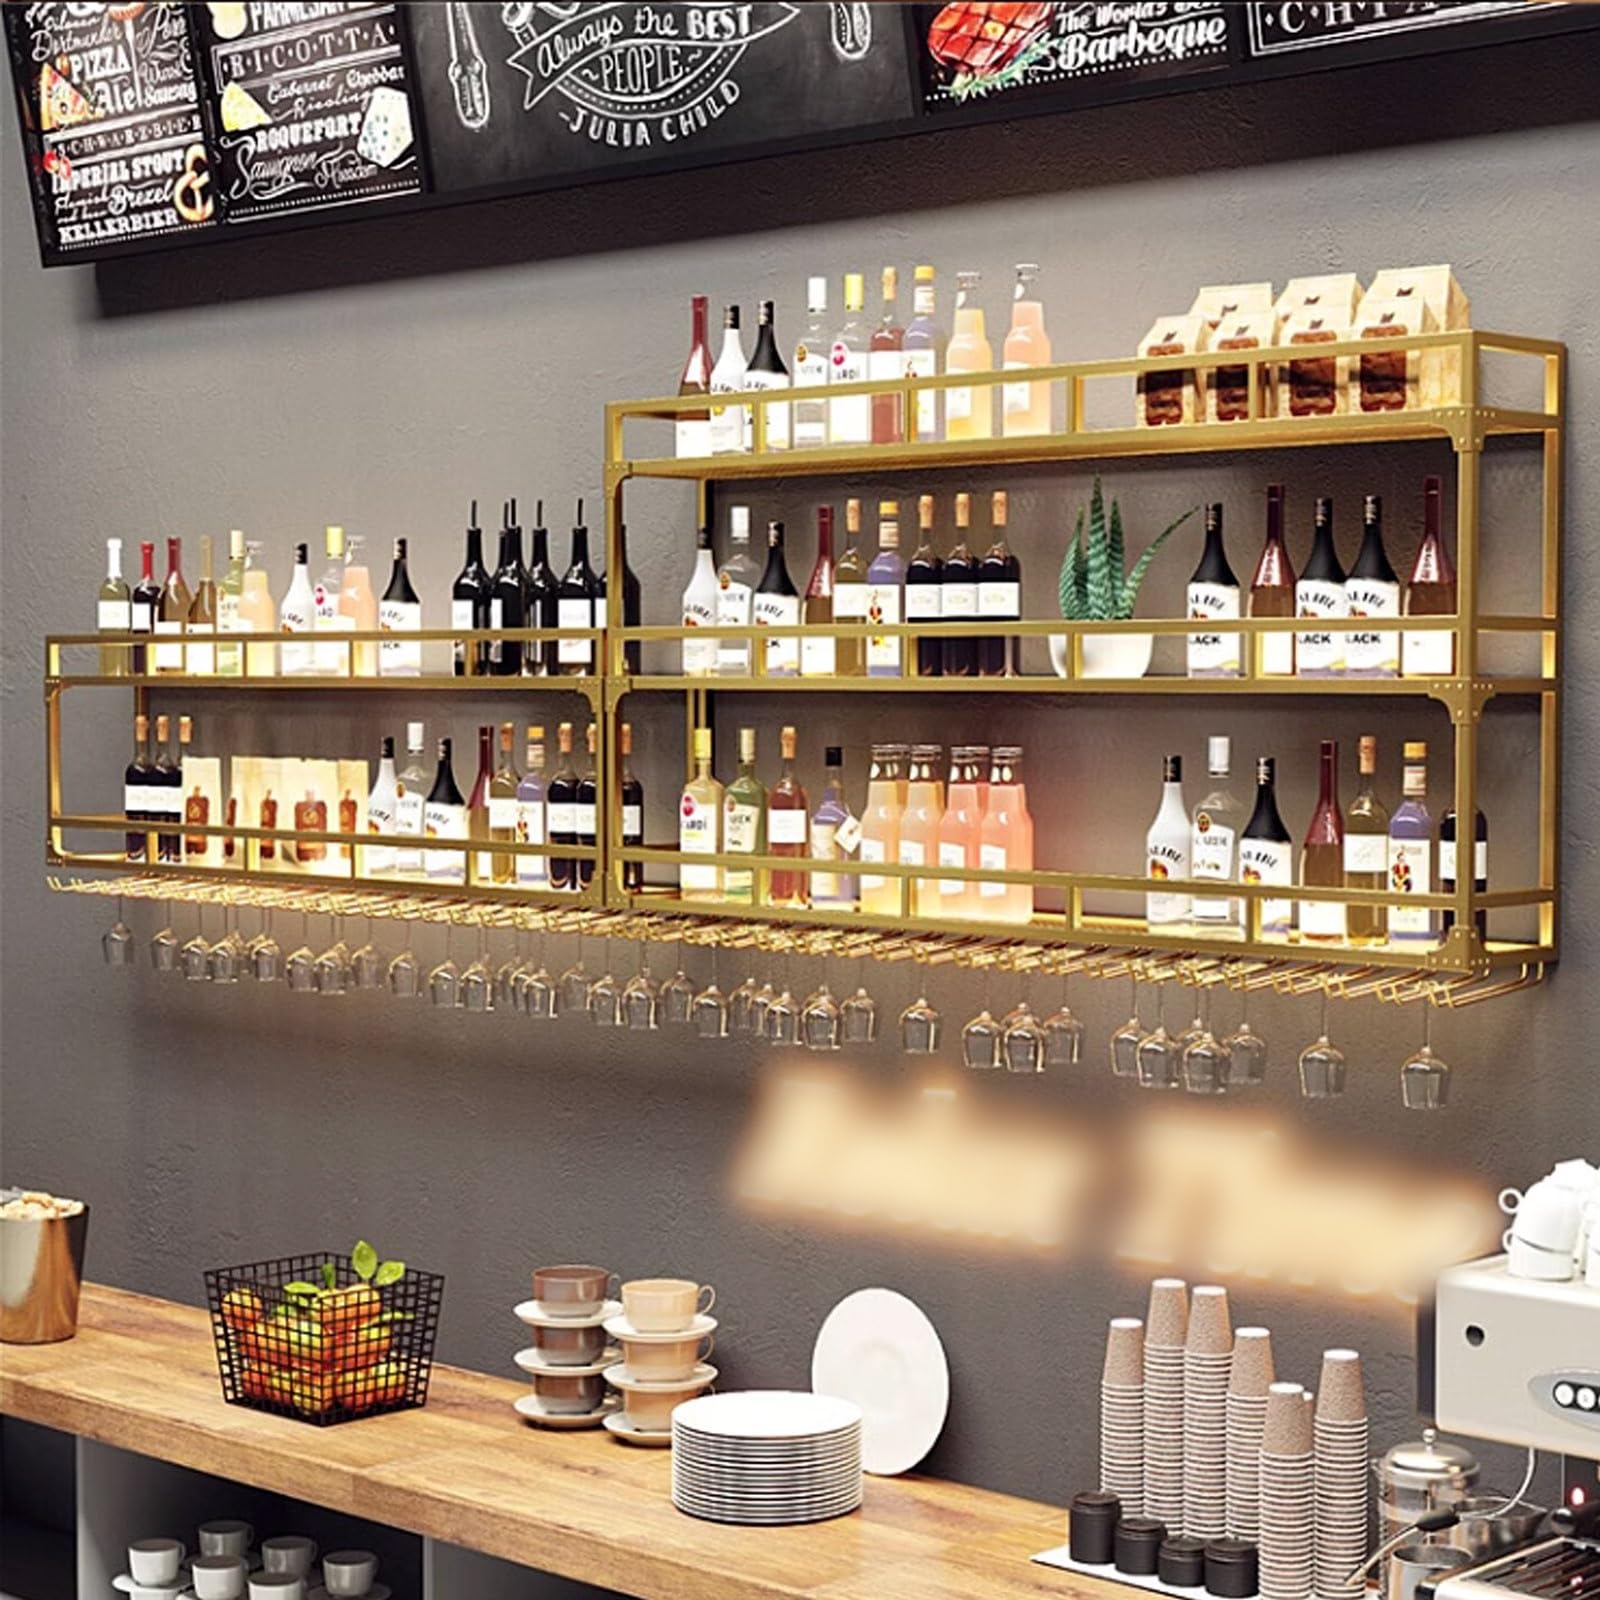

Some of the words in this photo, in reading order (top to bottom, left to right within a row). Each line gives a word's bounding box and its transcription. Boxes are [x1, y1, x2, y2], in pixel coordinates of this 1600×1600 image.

[537, 14, 623, 78] Always
[633, 6, 679, 38] the
[687, 4, 753, 40] BEST
[1055, 13, 1091, 35] The
[1057, 17, 1227, 71] Barbeque
[68, 44, 132, 84] PIZZA
[600, 44, 684, 94] PEOPLE
[661, 79, 740, 142] CHILD
[255, 111, 362, 151] ROQUEFORT
[131, 149, 184, 180] STOUT
[57, 208, 179, 244] KELLERBIER
